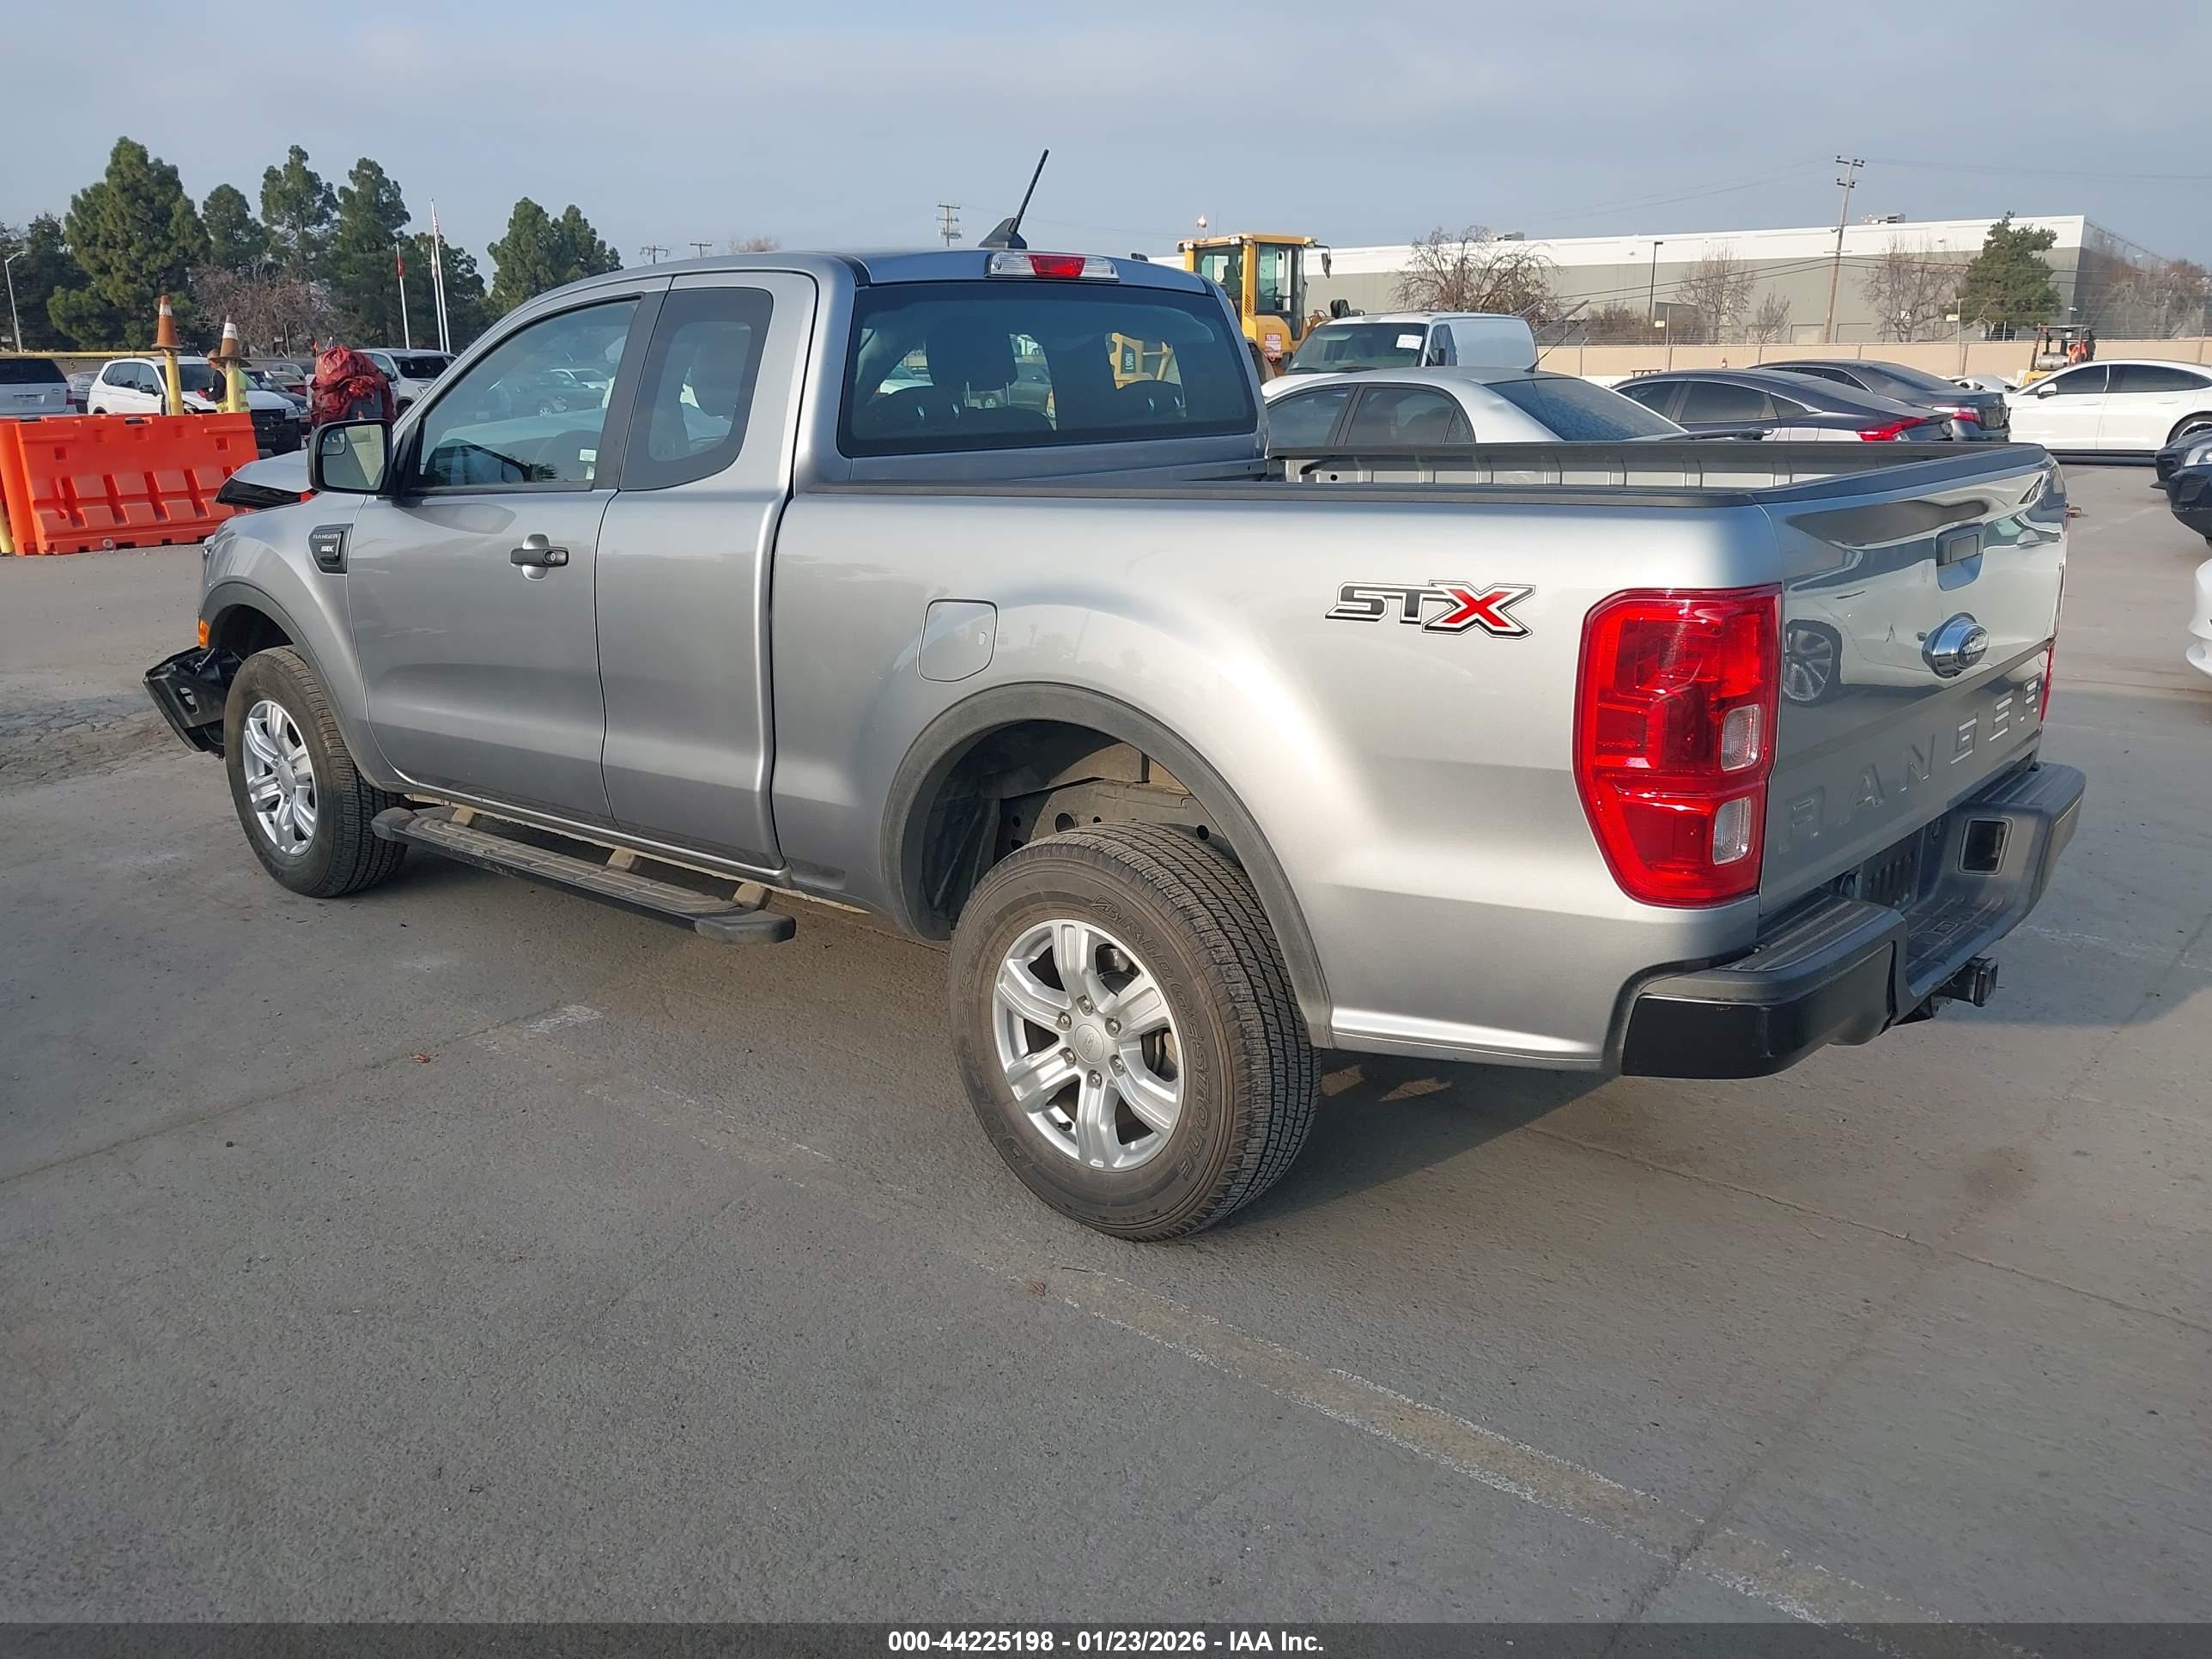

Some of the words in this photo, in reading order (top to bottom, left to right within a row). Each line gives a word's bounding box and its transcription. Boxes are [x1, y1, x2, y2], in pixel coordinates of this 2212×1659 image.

[70, 362, 76, 370] 5
[1325, 579, 1537, 641] STX
[1779, 672, 2042, 854] RANGER
[1091, 895, 1212, 1182] BRIDGESTONE
